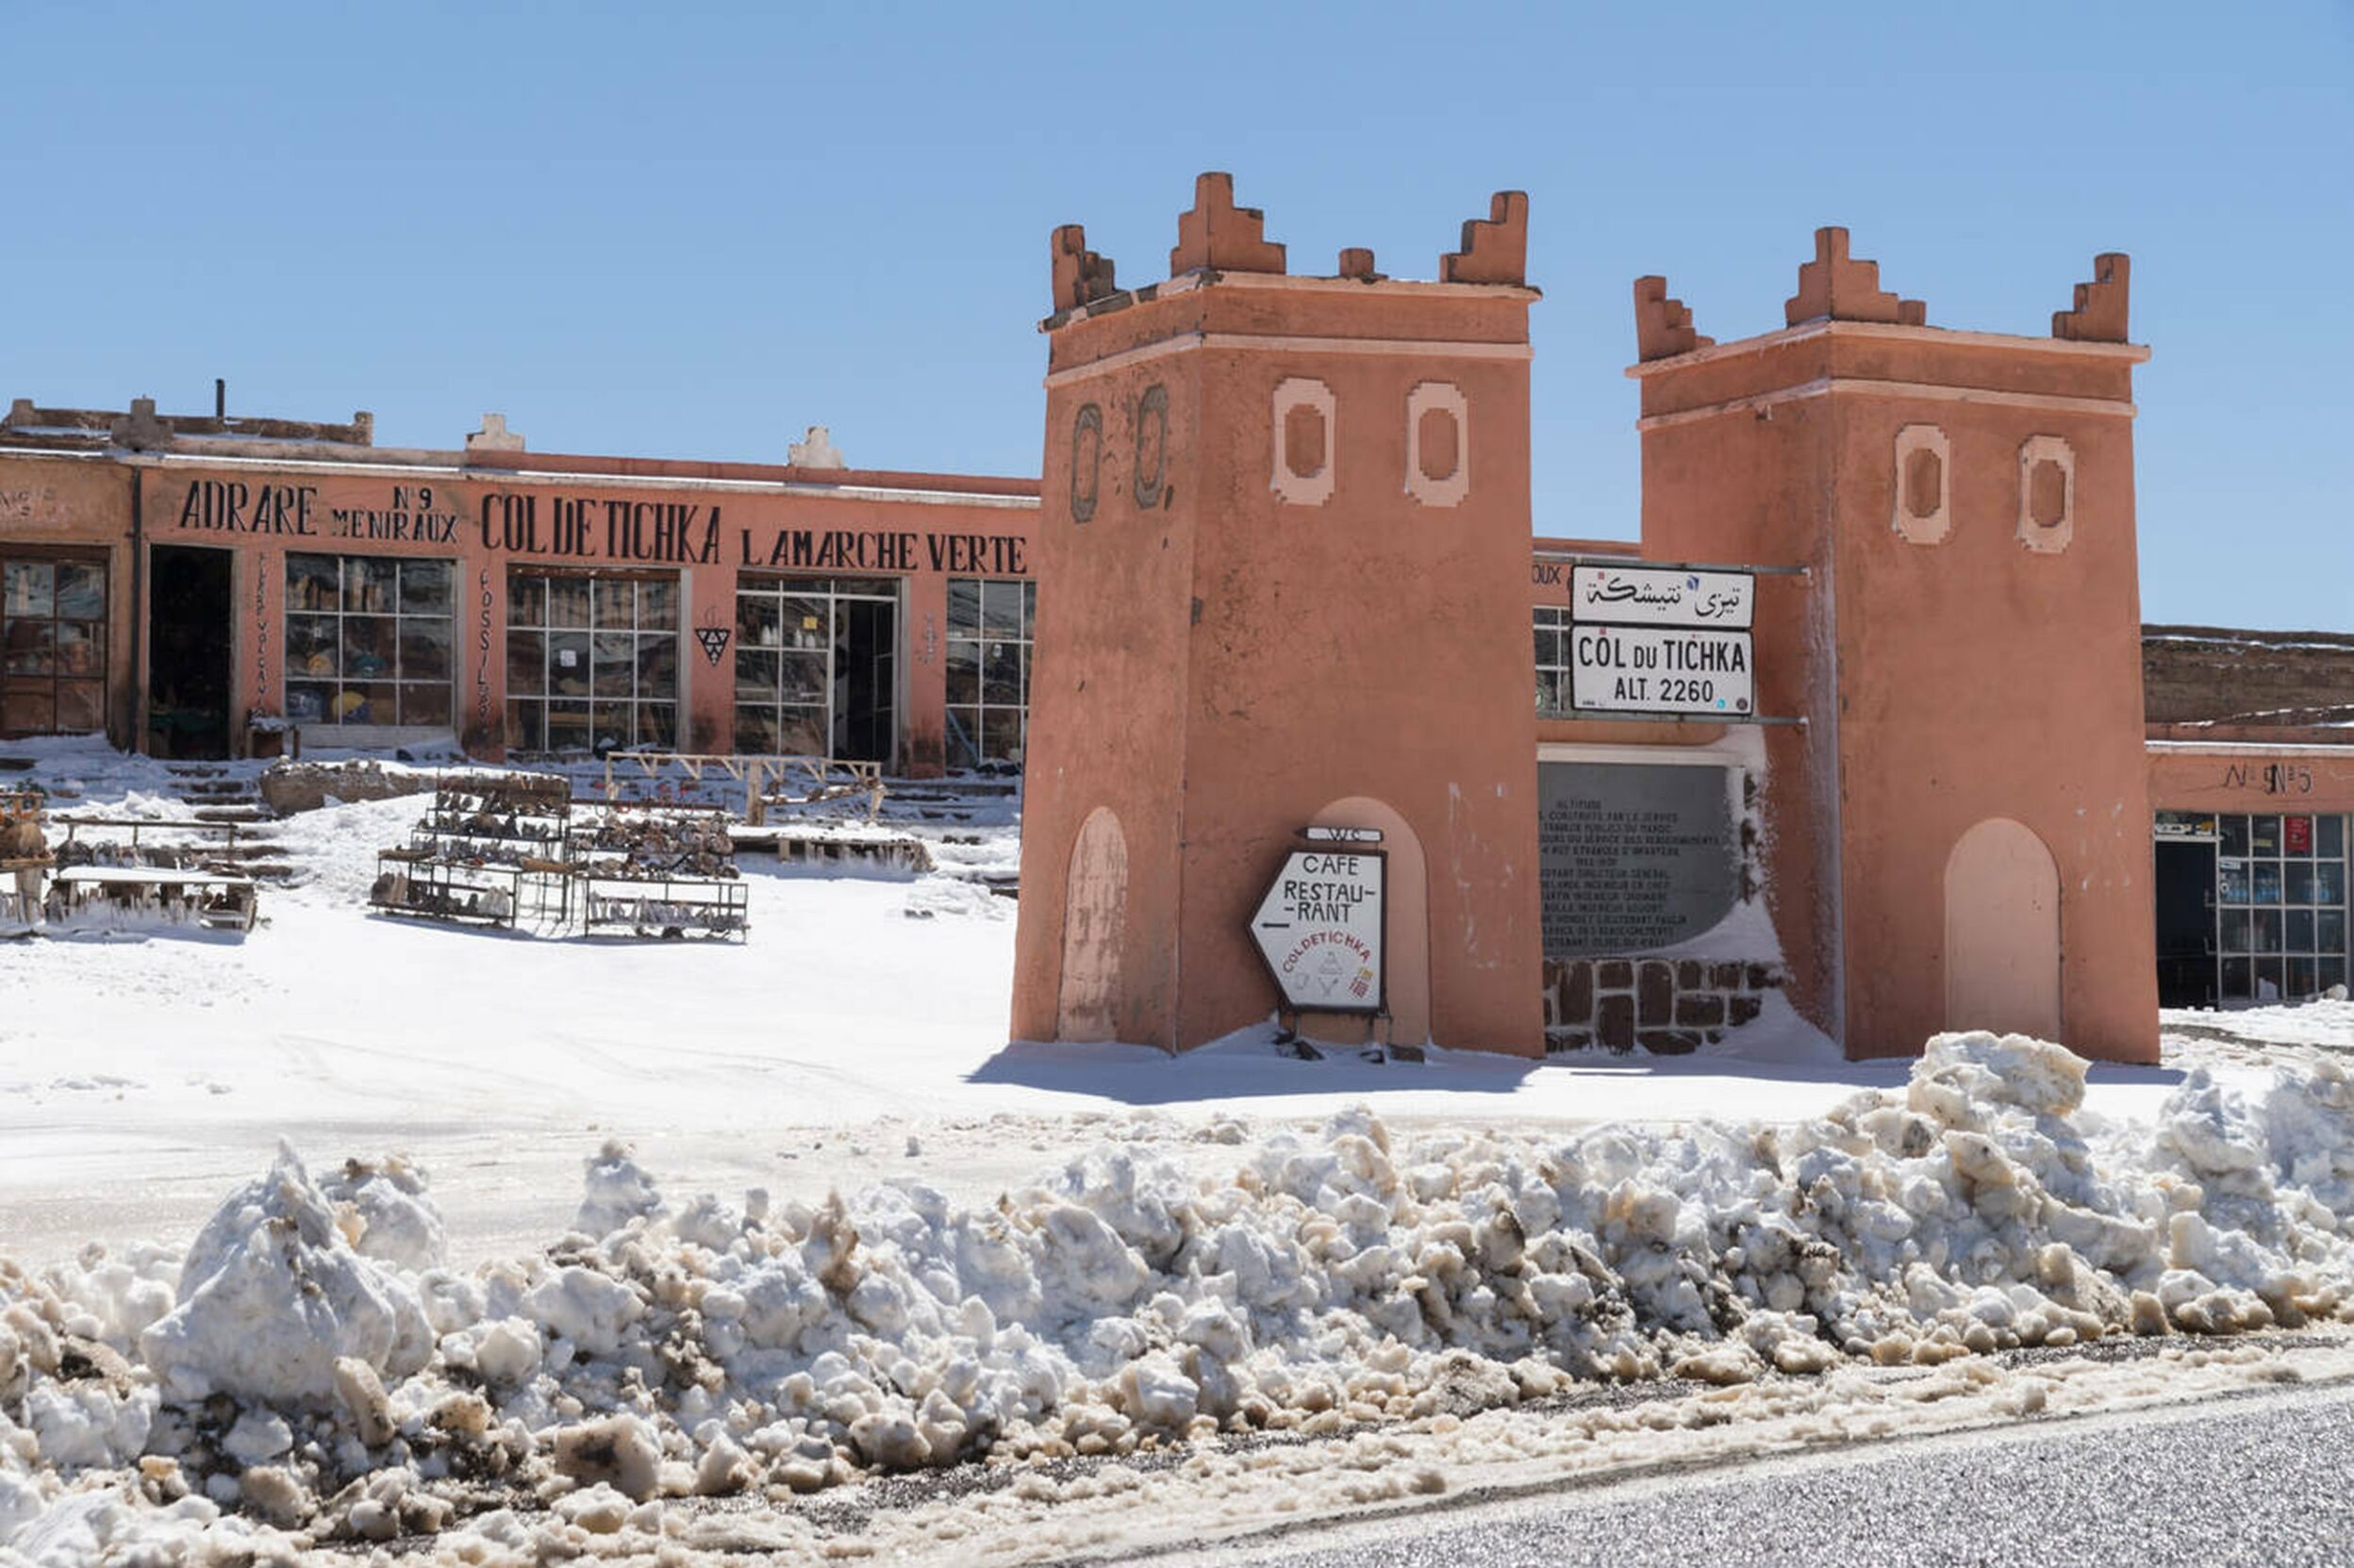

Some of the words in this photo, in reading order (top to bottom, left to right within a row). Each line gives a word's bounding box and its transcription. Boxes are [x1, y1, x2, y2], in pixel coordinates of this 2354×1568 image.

[179, 480, 318, 536] ADRARE
[419, 487, 432, 510] 9
[331, 509, 457, 544] MENIRAUX
[481, 493, 547, 554] COL
[553, 497, 597, 557] DE
[603, 501, 721, 565] TICHKA
[926, 533, 1028, 574] VERTE
[1579, 636, 1627, 668] COL
[1633, 645, 1658, 669] DU
[1663, 639, 1746, 672] TICHKA
[1659, 678, 1714, 702] 2260
[1302, 855, 1359, 876] CAFE
